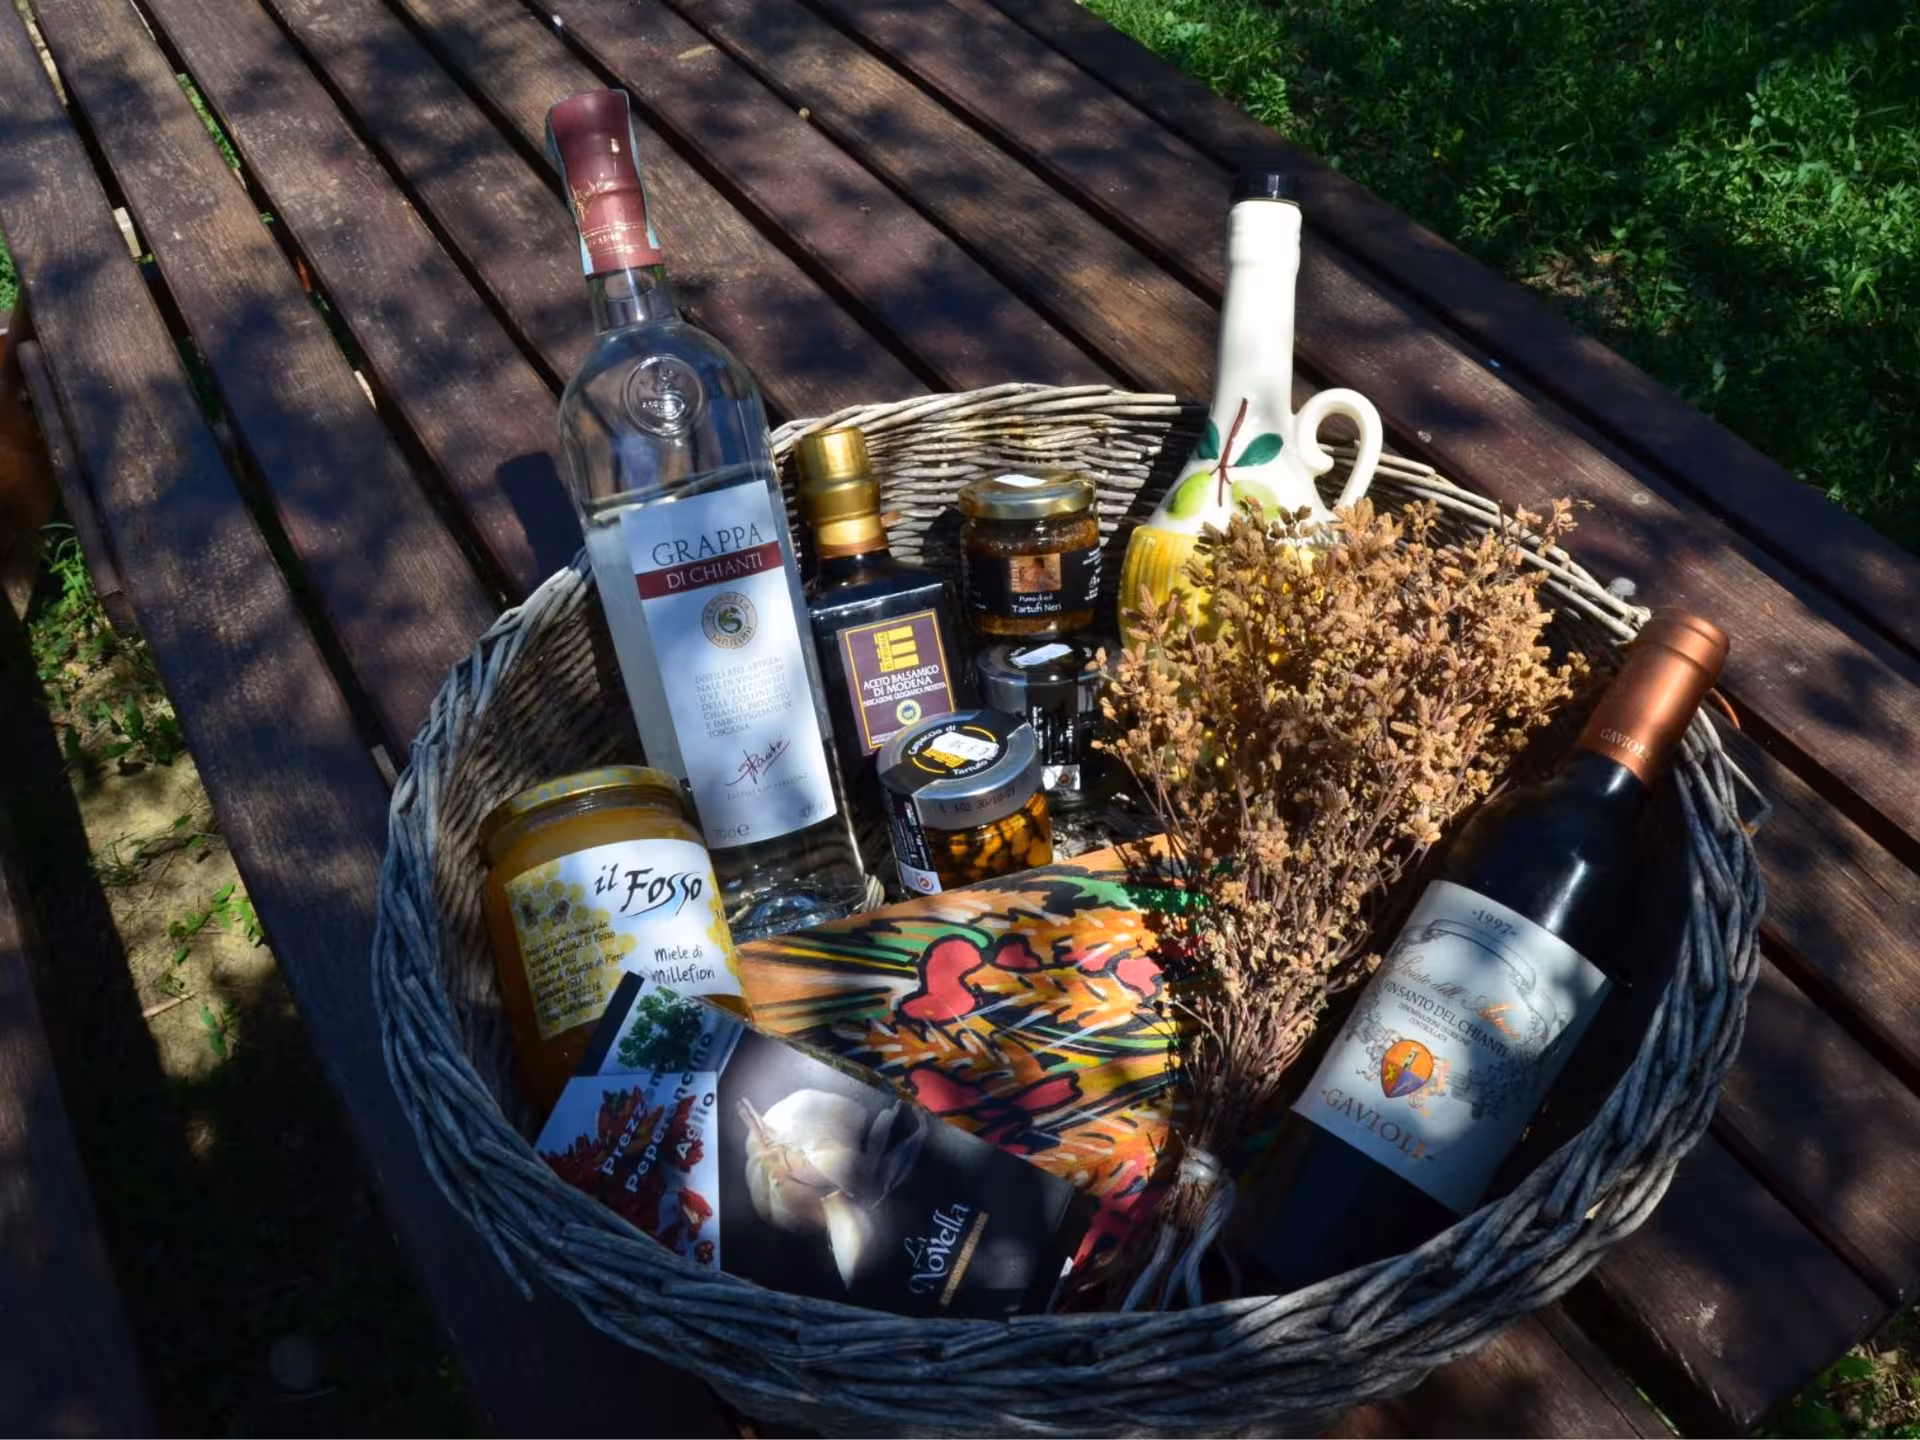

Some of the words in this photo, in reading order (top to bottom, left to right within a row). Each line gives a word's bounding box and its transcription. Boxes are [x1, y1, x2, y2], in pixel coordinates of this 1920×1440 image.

[652, 522, 764, 567] GRAPPA
[666, 572, 684, 590] DI
[690, 553, 764, 583] CHIANTI
[1044, 602, 1062, 612] Neri
[863, 675, 891, 691] ACETO
[891, 664, 940, 684] BALSAMICO
[873, 687, 885, 698] DI
[886, 676, 933, 695] MODENA
[952, 759, 988, 776] Tartufo
[594, 863, 619, 897] il
[619, 867, 704, 919] Fosso
[654, 944, 689, 963] Miele
[692, 947, 704, 960] di
[1433, 1003, 1457, 1027] DEL
[1458, 1020, 1511, 1058] CHIANTI
[676, 1092, 715, 1160] Aglio
[910, 1203, 970, 1294] Novella
